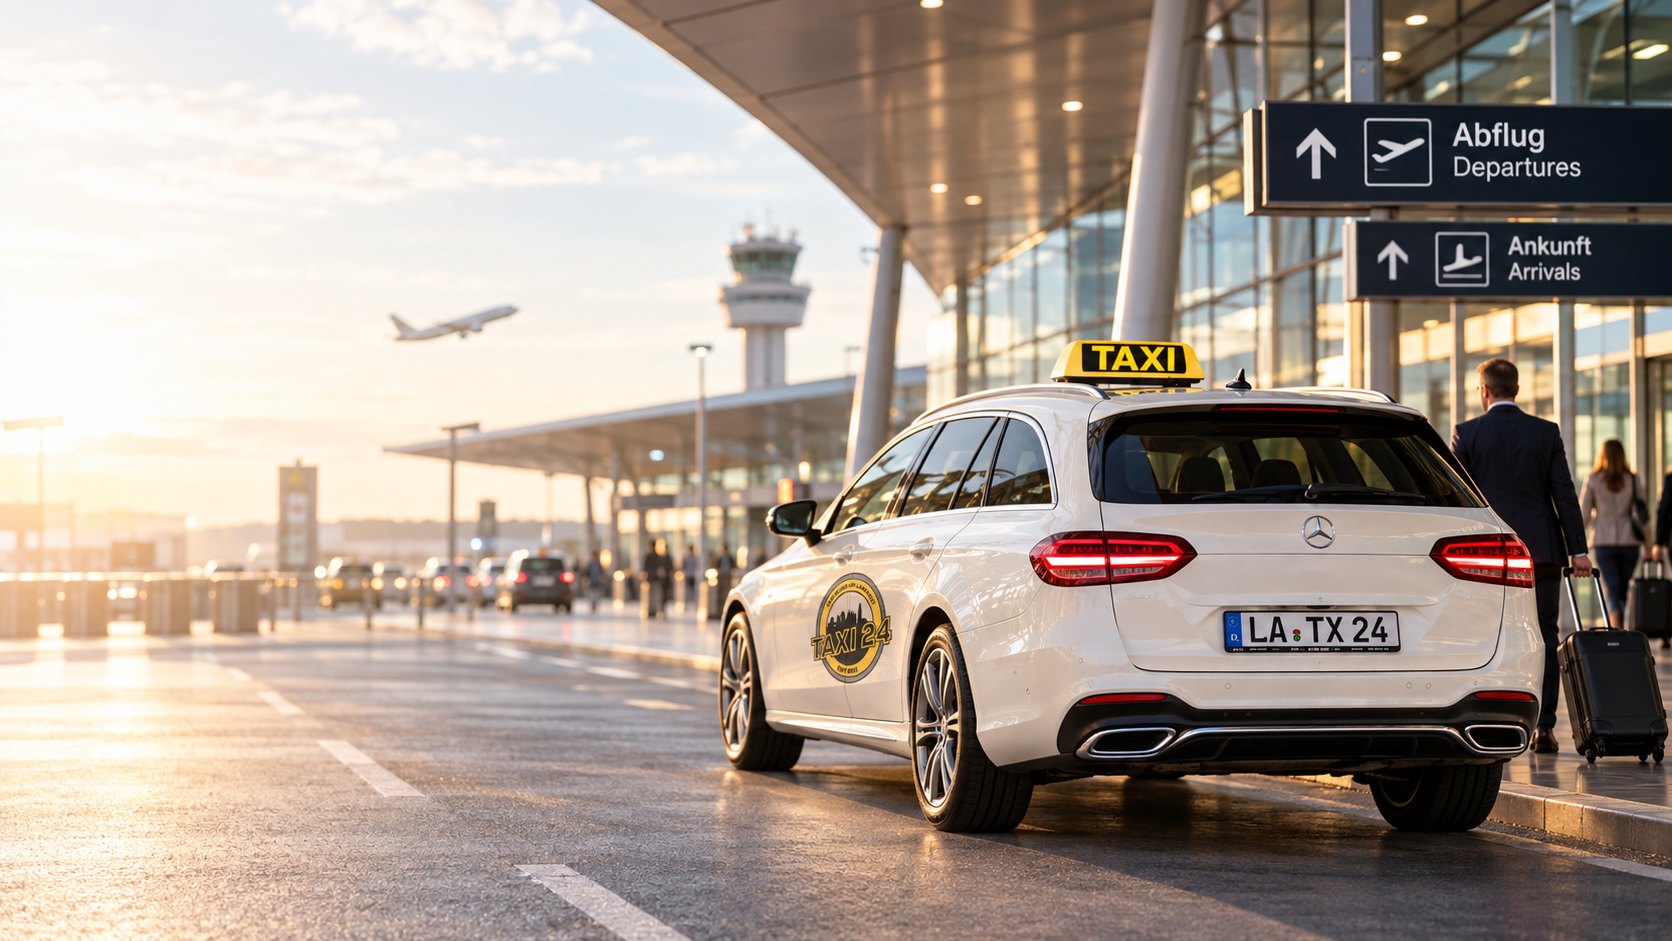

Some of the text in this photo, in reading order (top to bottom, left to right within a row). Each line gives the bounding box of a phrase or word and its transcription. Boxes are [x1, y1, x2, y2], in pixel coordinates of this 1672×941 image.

[1452, 122, 1545, 154] Abflug
[1453, 155, 1582, 182] Departures
[1507, 235, 1592, 256] Ankunft
[1508, 261, 1581, 281] Arrivals
[1091, 345, 1176, 372] TAXI
[810, 615, 893, 661] TAXI 24
[1249, 616, 1389, 643] LA TX 24
